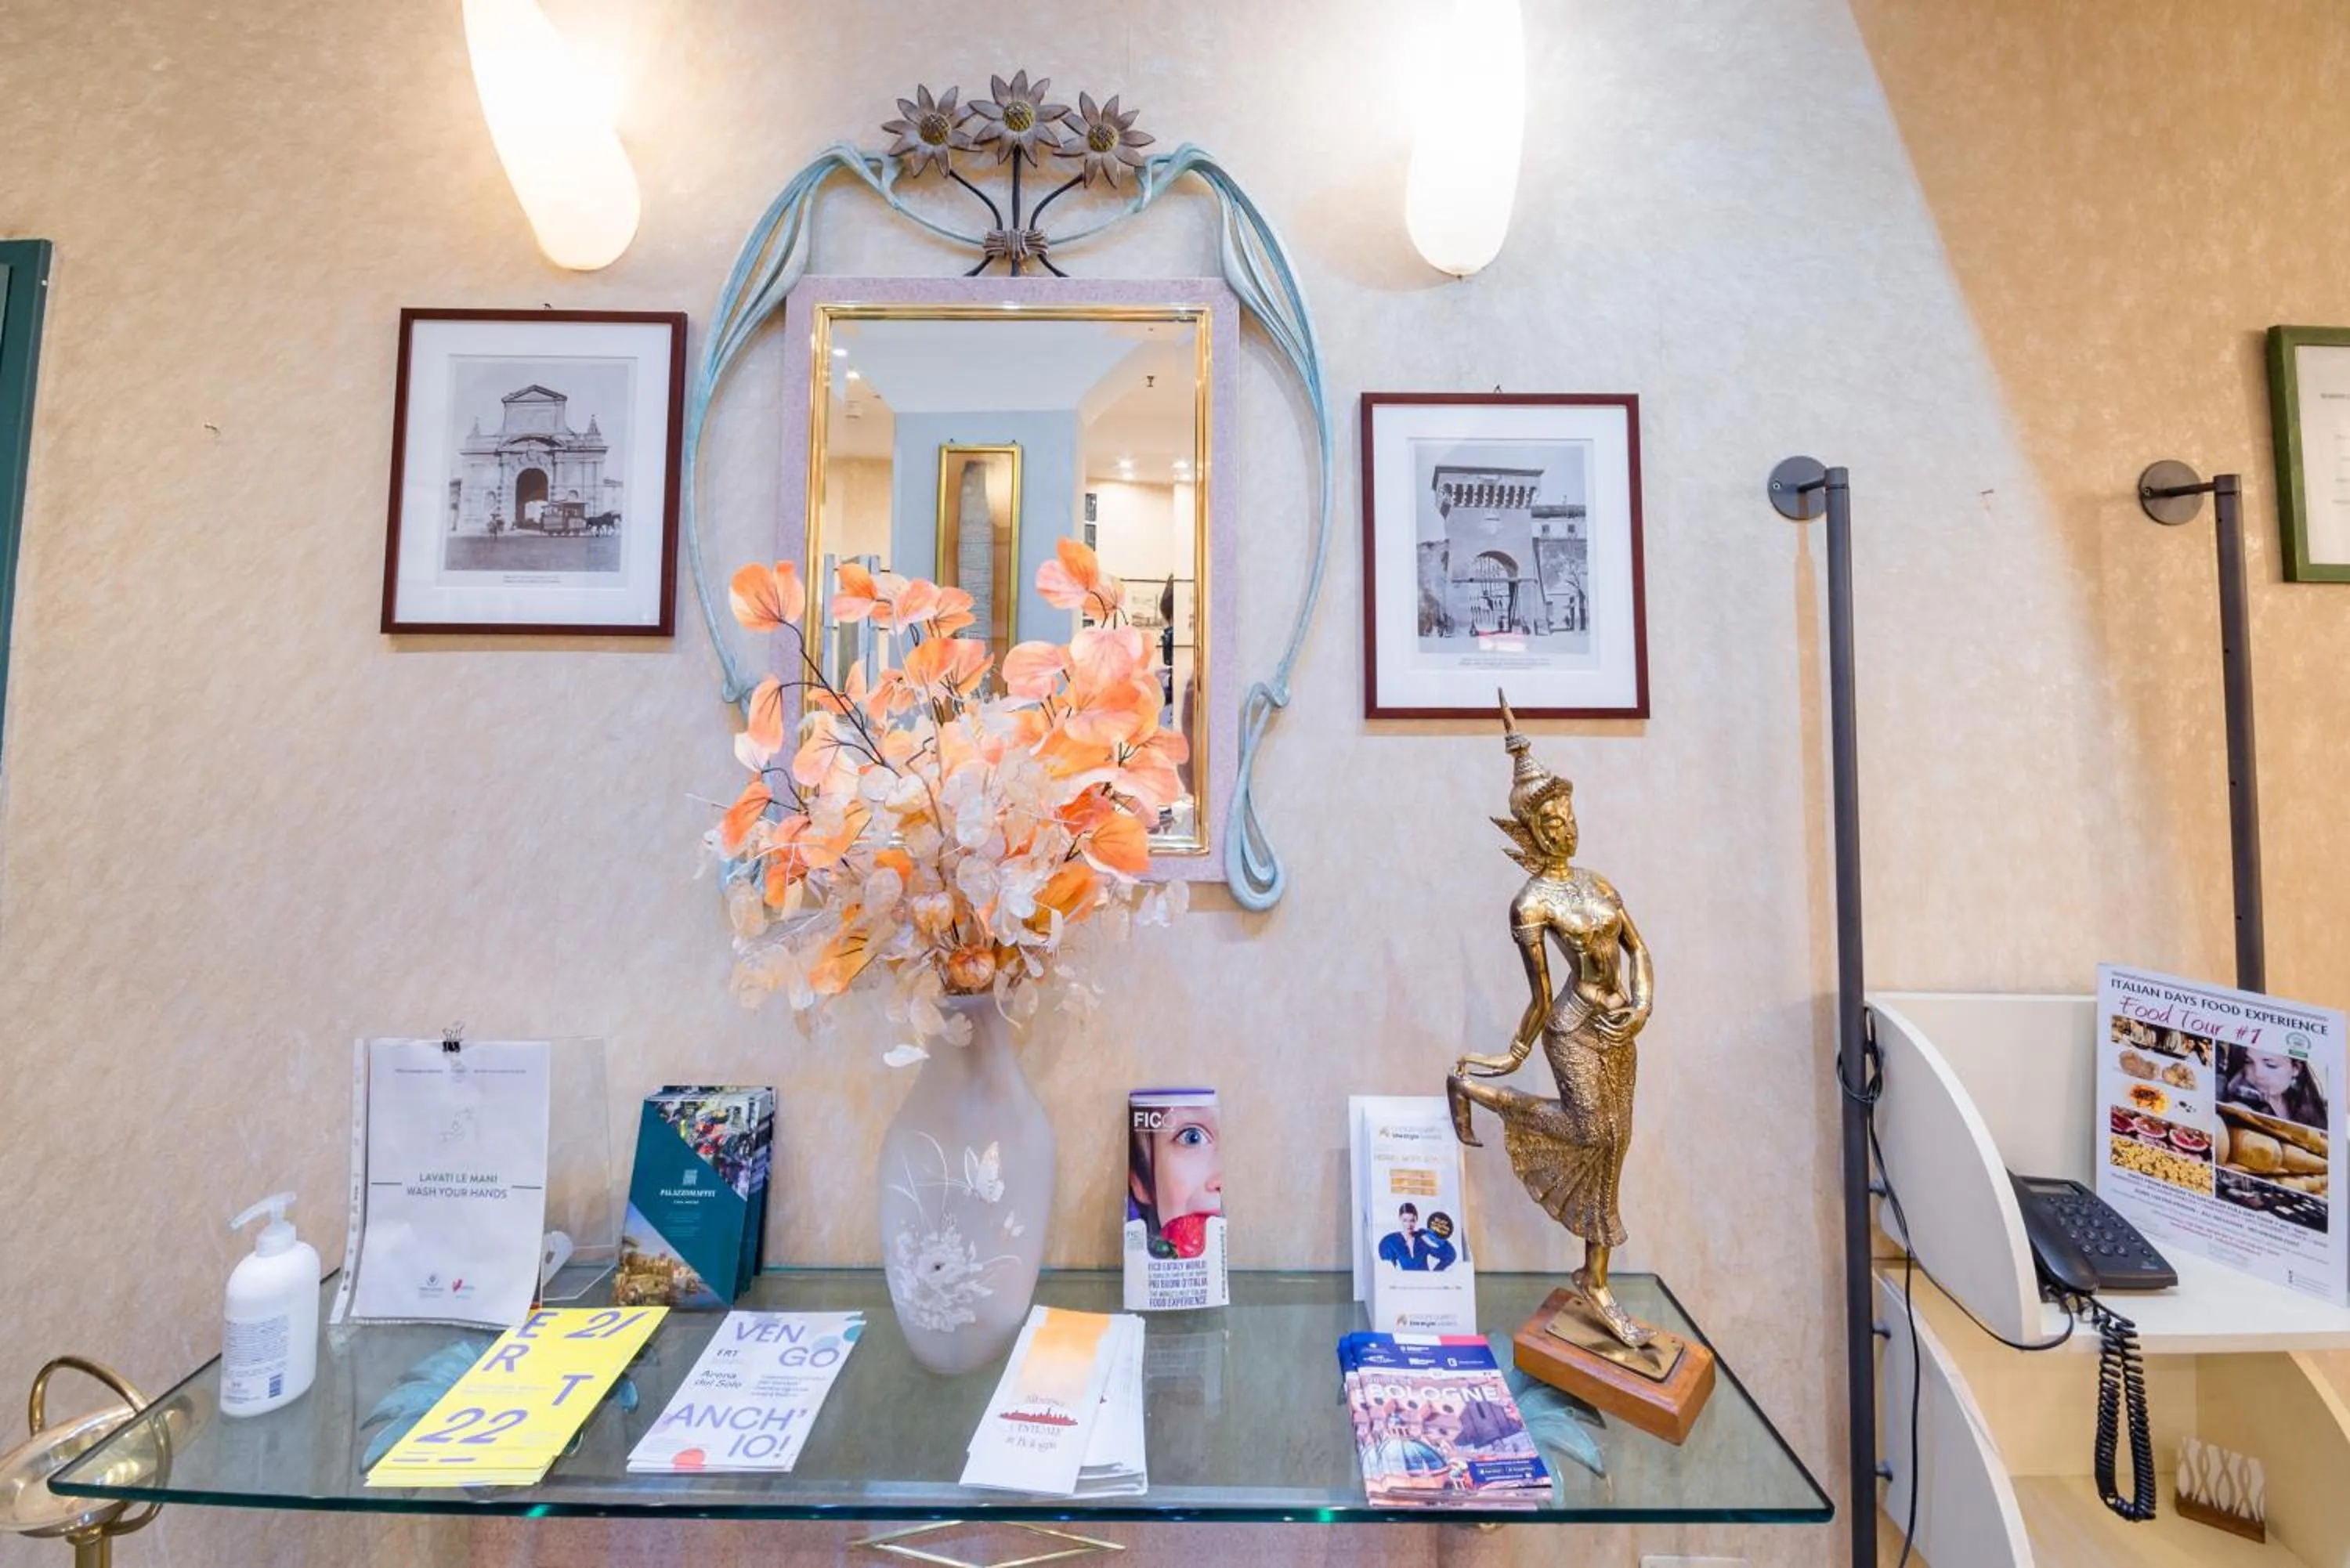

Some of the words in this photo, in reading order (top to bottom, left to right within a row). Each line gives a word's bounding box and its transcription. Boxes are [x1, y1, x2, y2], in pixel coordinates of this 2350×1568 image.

[2110, 977, 2160, 998] ITALIAN
[2164, 990, 2197, 1006] DAYS
[2201, 999, 2240, 1015] FOOD
[2245, 1008, 2329, 1035] EXPERIENCE
[2119, 995, 2174, 1024] Food
[2179, 1009, 2225, 1036] Tour
[1133, 1108, 1176, 1129] FICO
[419, 1172, 454, 1182] LAVATI
[455, 1173, 468, 1183] LE
[469, 1174, 497, 1183] MANI
[407, 1187, 437, 1197] WASH
[439, 1187, 468, 1198] YOUR
[470, 1188, 508, 1198] HANDS
[515, 1312, 559, 1338] E
[736, 1321, 805, 1343] VEN
[482, 1344, 530, 1372] R
[779, 1346, 841, 1367] GO
[551, 1375, 595, 1406] T
[1366, 1384, 1501, 1402] BOLOGNE
[413, 1407, 529, 1444] 22
[662, 1403, 808, 1431] ANCH'
[728, 1433, 791, 1458] IO!
